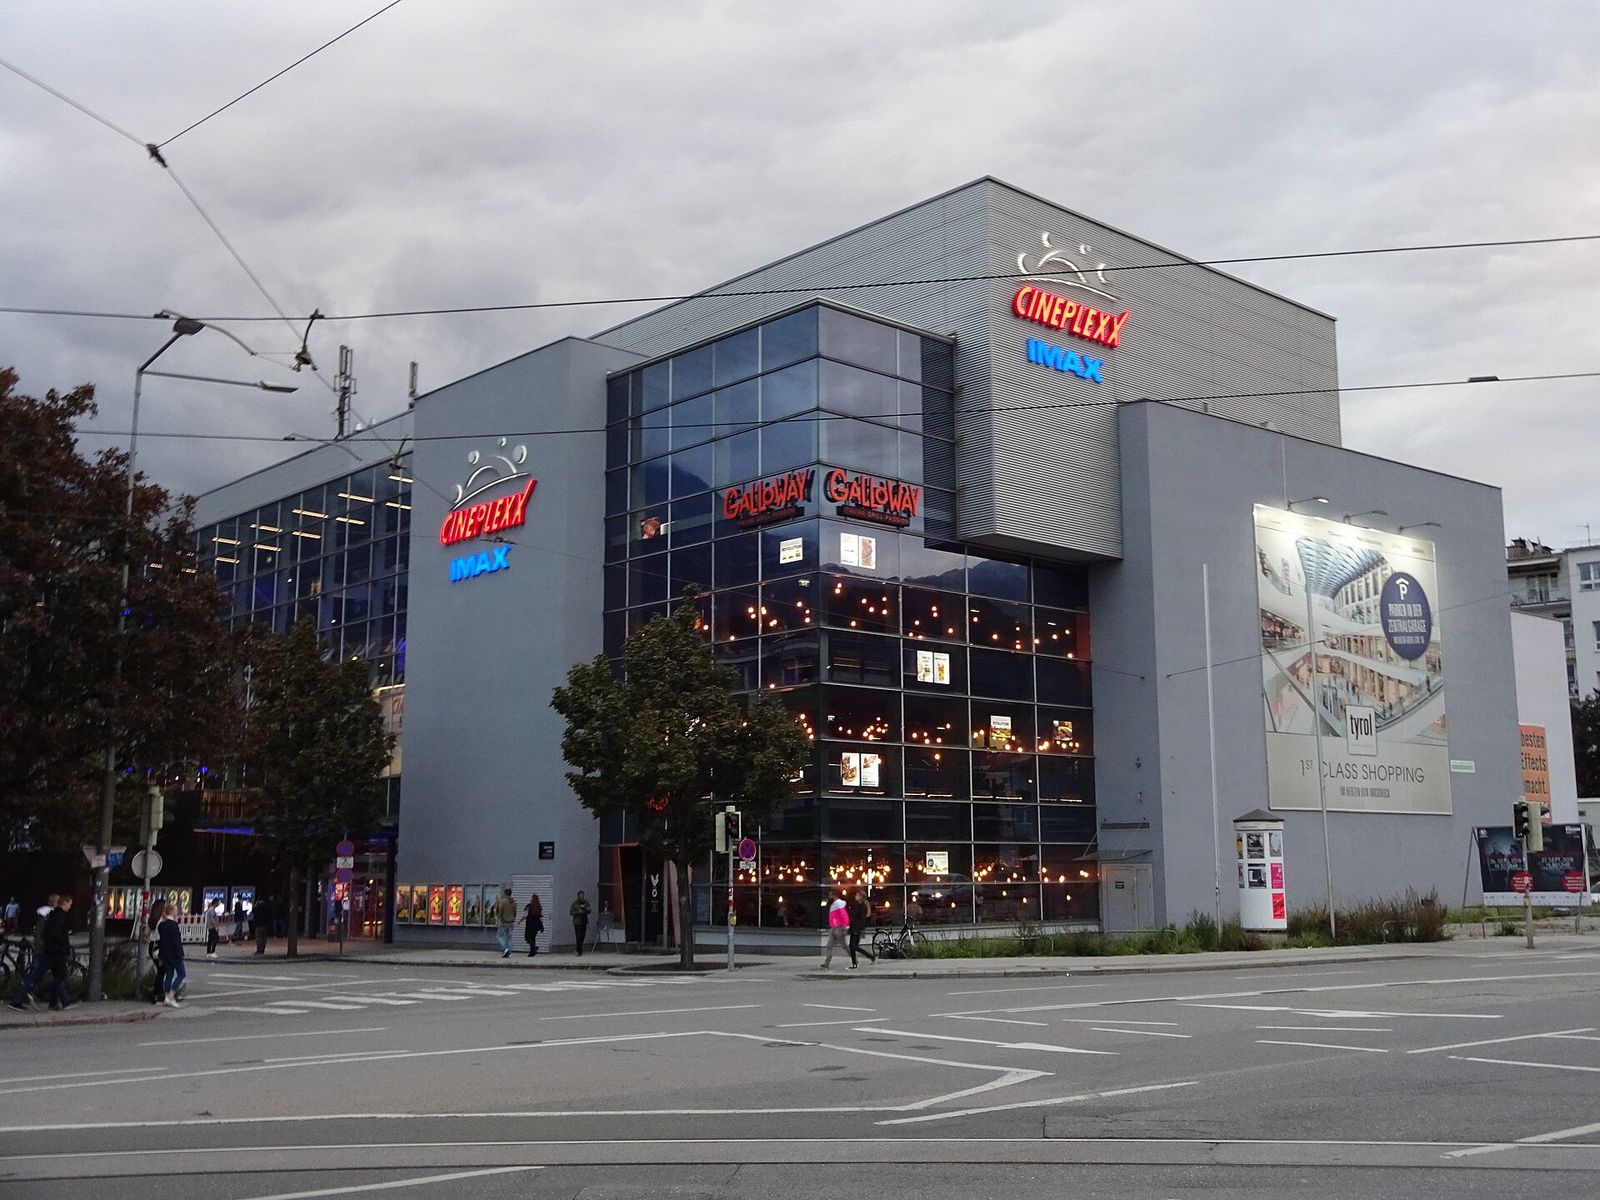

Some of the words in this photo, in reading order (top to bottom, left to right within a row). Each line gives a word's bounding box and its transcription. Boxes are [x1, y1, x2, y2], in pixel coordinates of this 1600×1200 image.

[1012, 285, 1131, 349] CINEPLEXX
[1026, 336, 1104, 384] IMAX
[439, 479, 538, 546] CINEPLEXX
[449, 544, 512, 582] IMAX
[1350, 713, 1373, 741] tyrol
[1520, 730, 1545, 748] besten
[1361, 763, 1425, 783] SHOPPING
